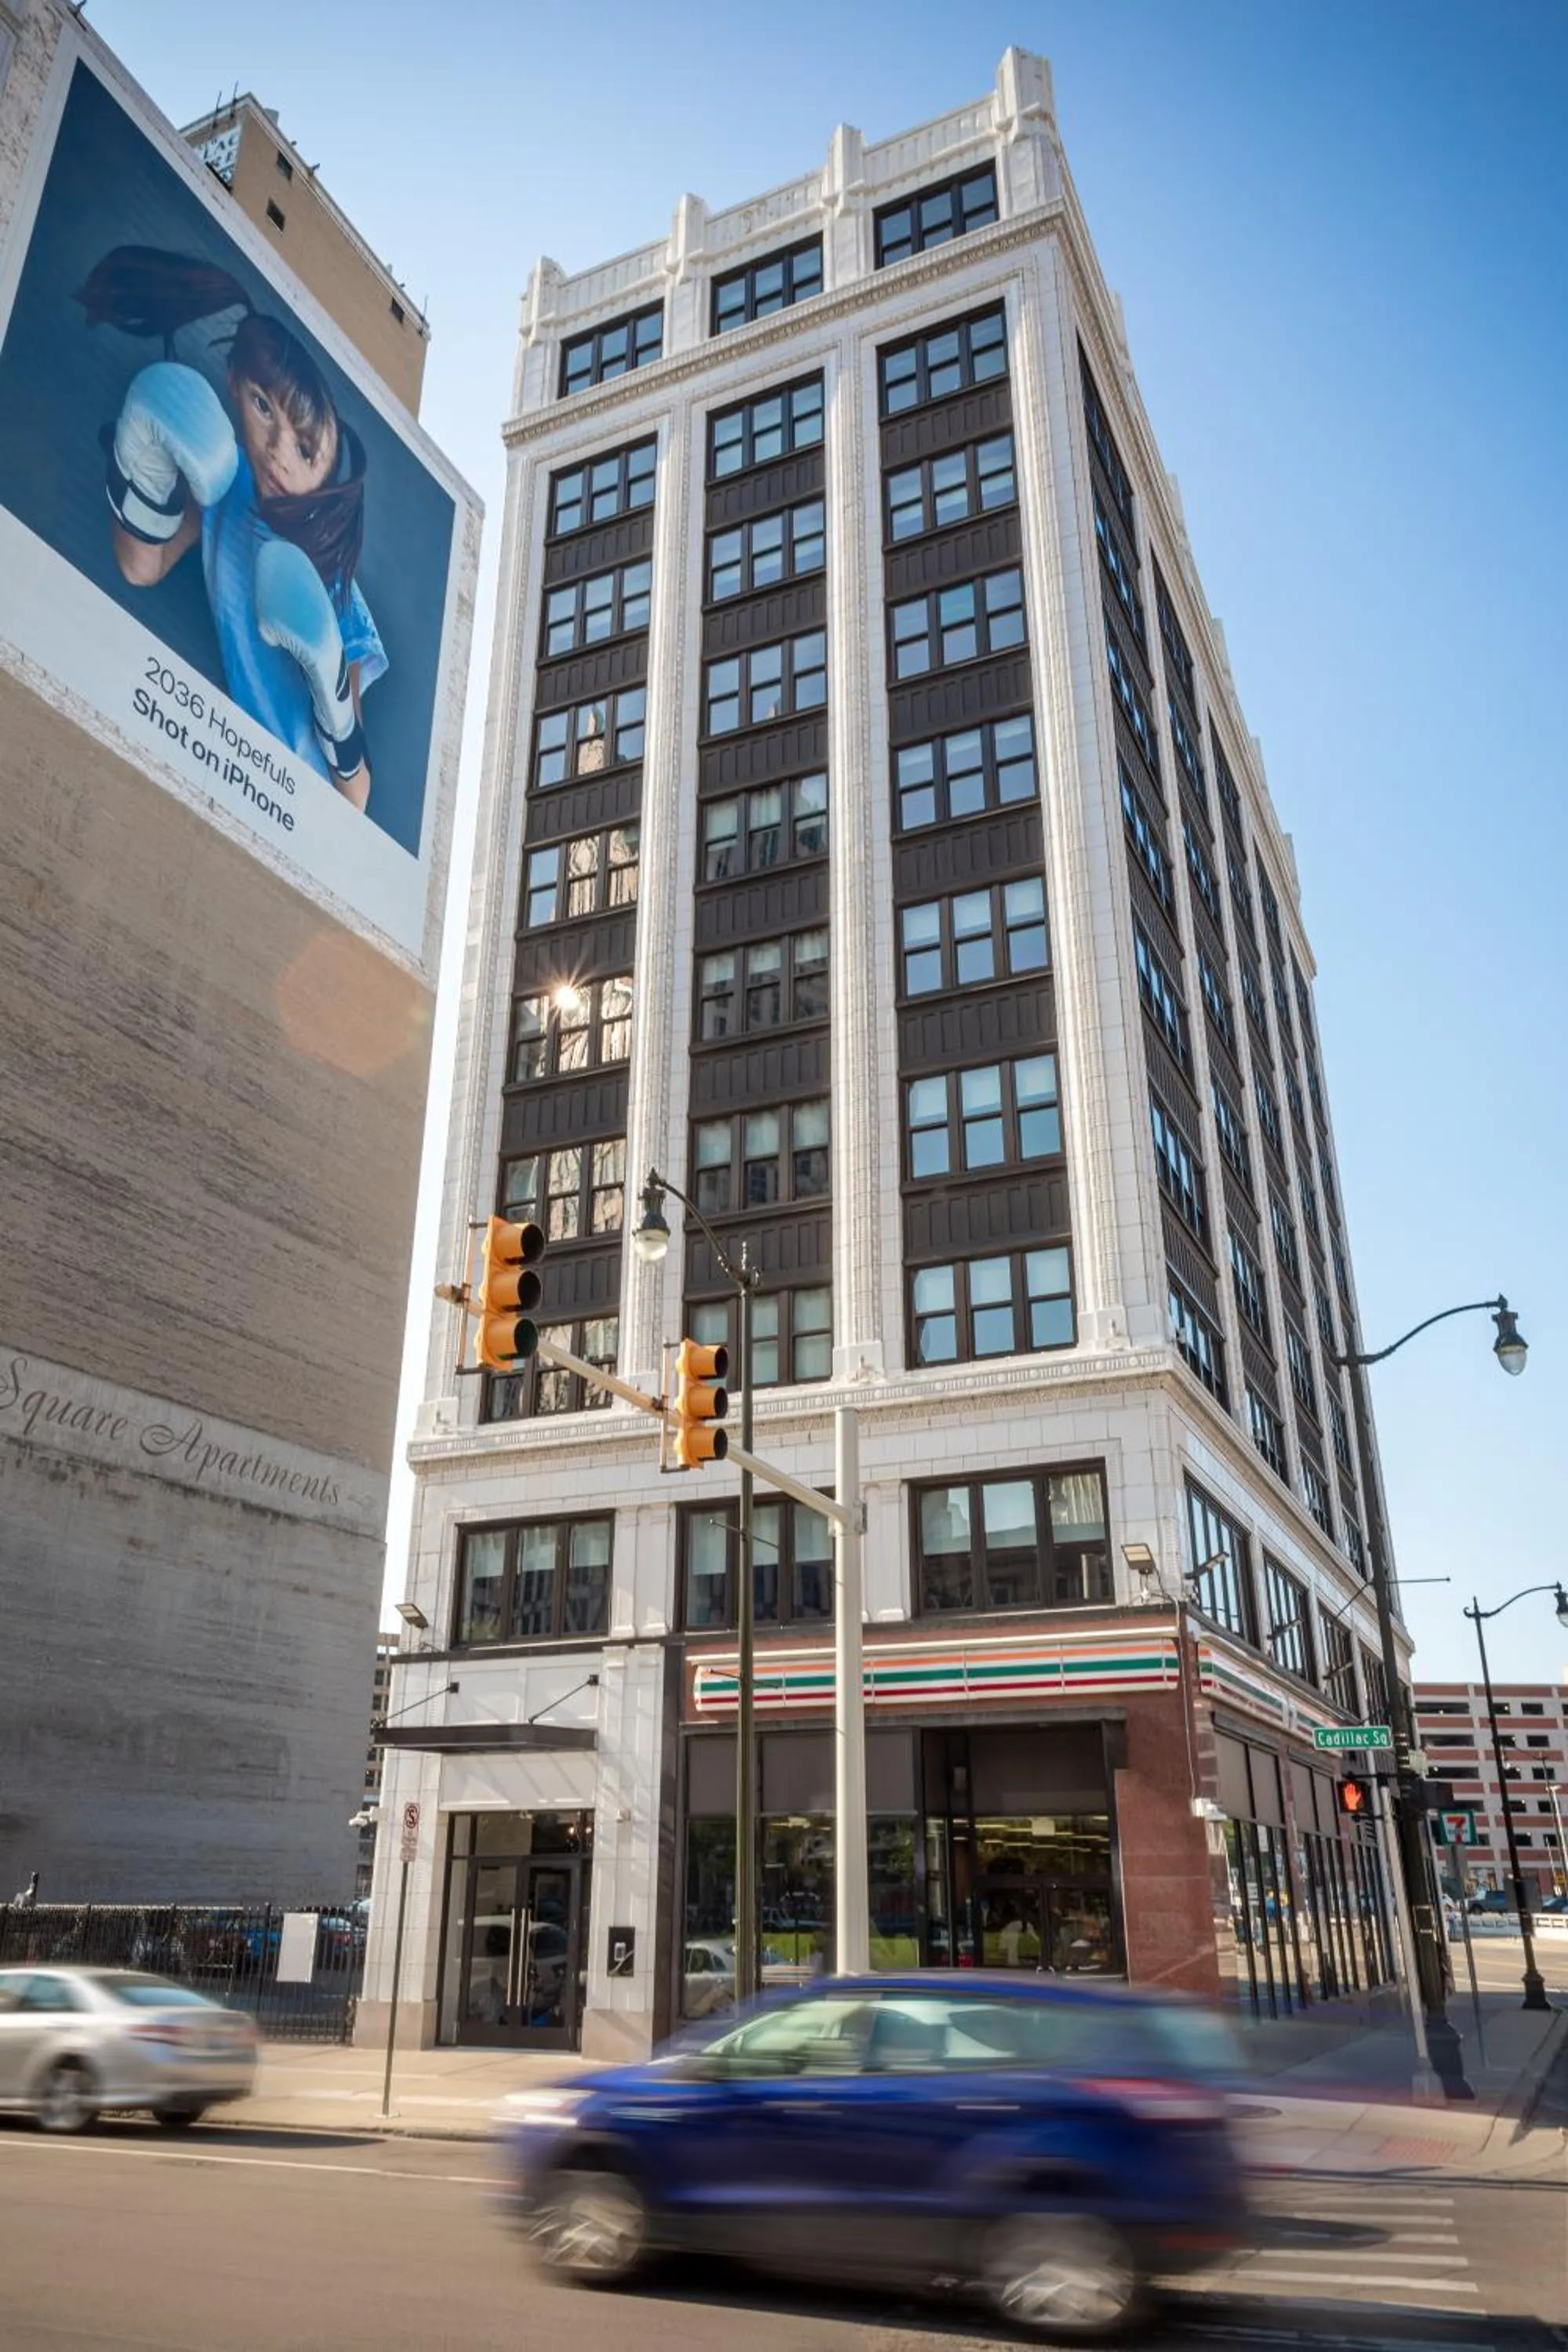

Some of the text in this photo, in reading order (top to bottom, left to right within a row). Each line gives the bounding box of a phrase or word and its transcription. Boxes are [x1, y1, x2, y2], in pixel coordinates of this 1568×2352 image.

[133, 688, 295, 831] Shot on iPhone
[145, 657, 296, 795] 2036 Hopefuls
[0, 1356, 339, 1506] Square Apartments
[1318, 1730, 1388, 1746] Cadillac Sq
[1446, 1815, 1467, 1842] 7
